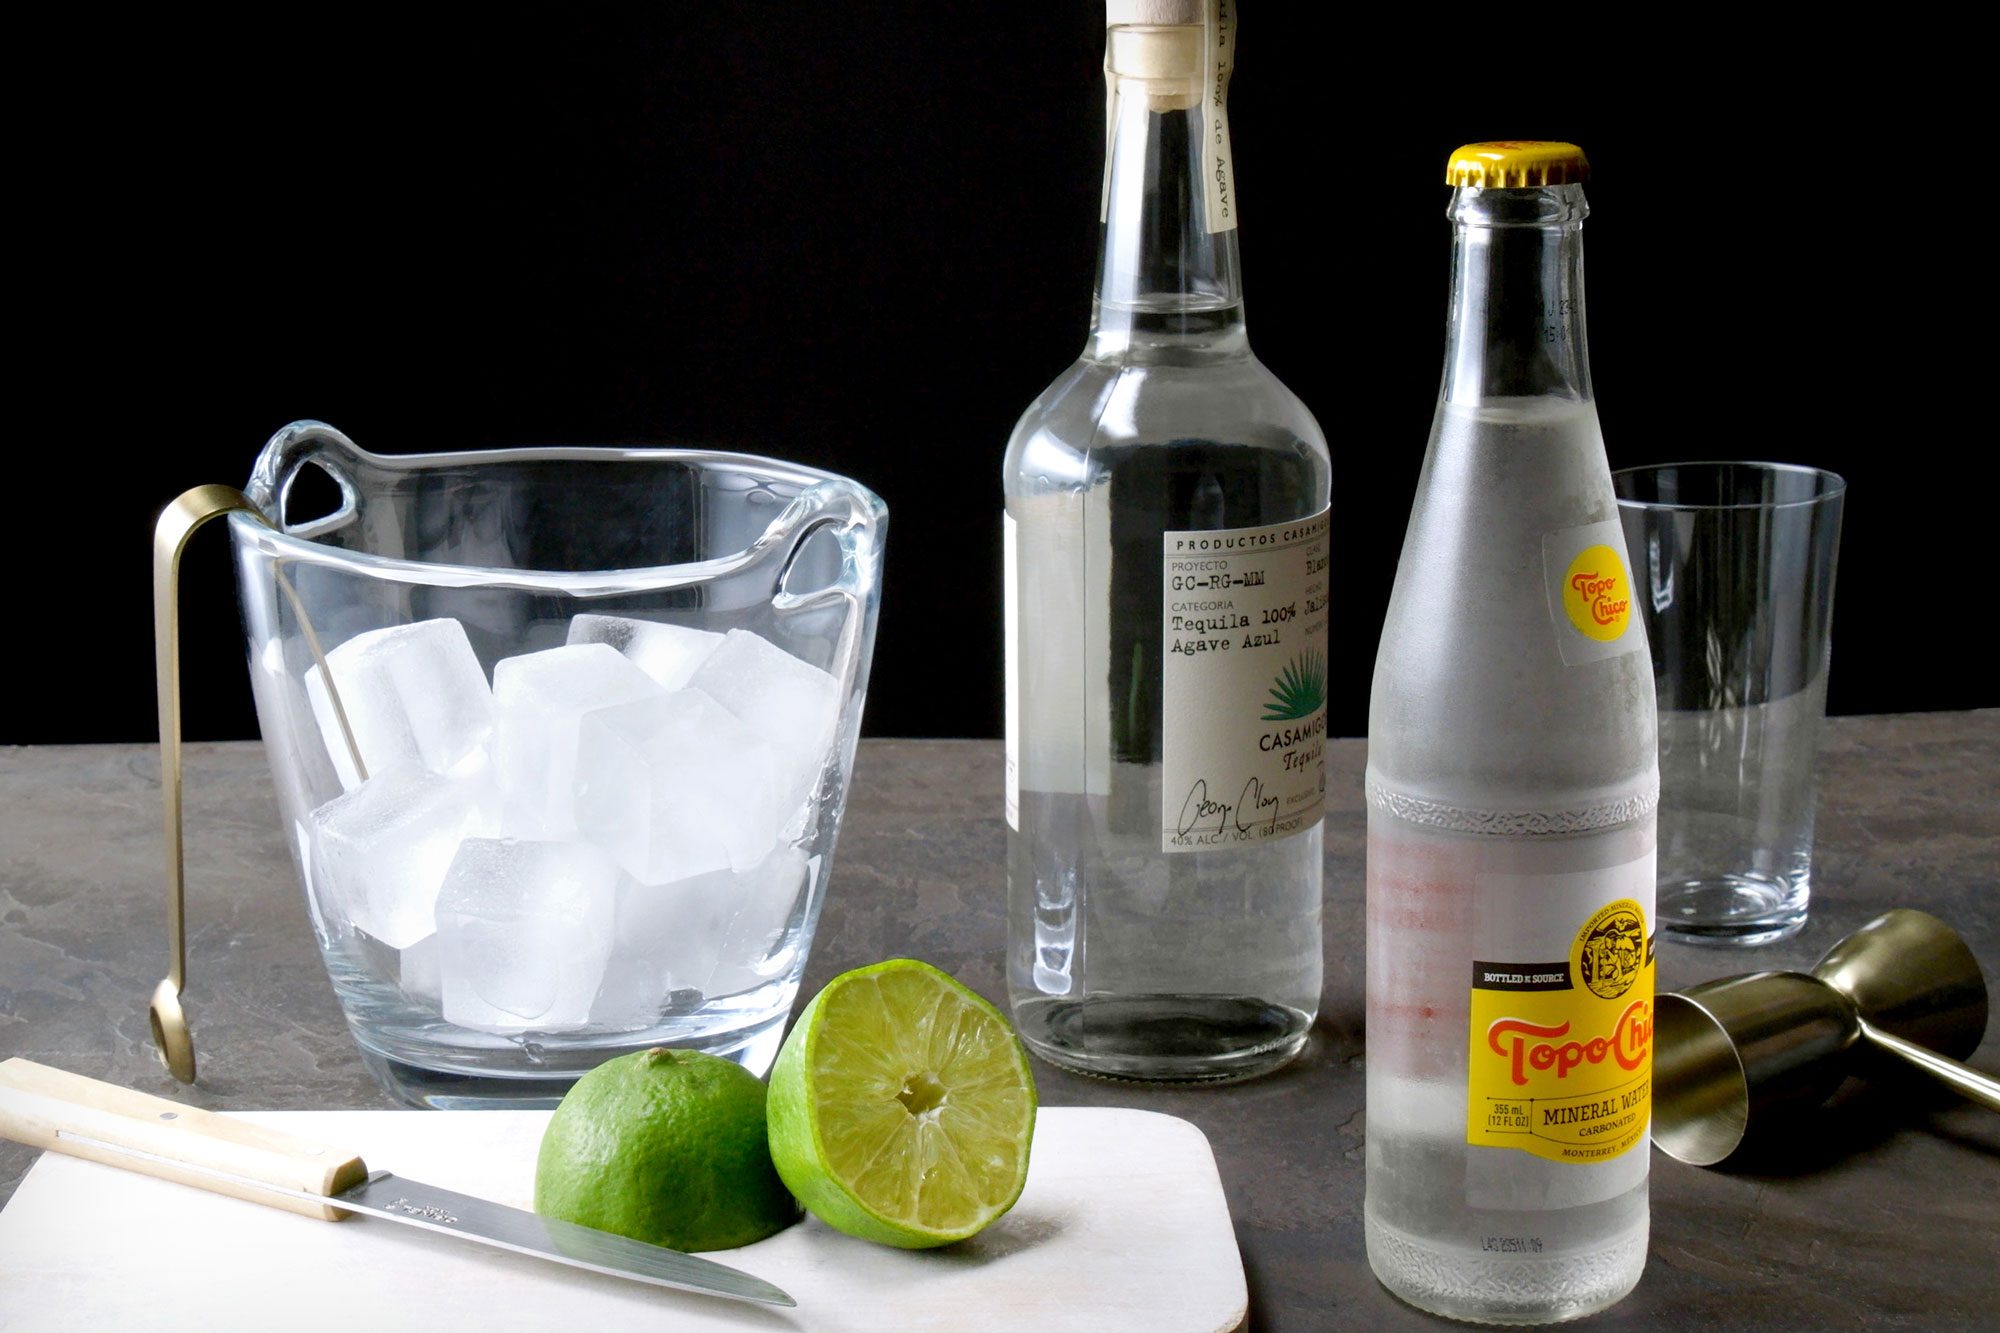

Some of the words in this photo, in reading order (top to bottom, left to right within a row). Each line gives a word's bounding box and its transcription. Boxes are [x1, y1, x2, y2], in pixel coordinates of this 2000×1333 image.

[1213, 61, 1226, 107] 100%
[1214, 119, 1223, 145] de
[1215, 156, 1229, 218] Agave
[1176, 533, 1276, 551] PRODUCTOS
[1171, 560, 1228, 572] PROYECTO
[1572, 571, 1616, 602] Topo
[1171, 600, 1235, 612] CATEGORIA
[1171, 613, 1250, 635] Tequila
[1262, 602, 1297, 624] 100%
[1592, 595, 1628, 626] Chico
[1171, 638, 1230, 656] Agave
[1242, 630, 1281, 650] Azul
[1170, 835, 1193, 846] 40%
[1197, 833, 1219, 845] ALC
[1231, 830, 1253, 841] VOL
[1579, 909, 1610, 942] IMPORTED
[1484, 973, 1523, 983] BOTTLED
[1532, 973, 1564, 983] SOURCE
[1488, 1017, 1609, 1086] Topo
[1494, 1103, 1509, 1115] 355
[1503, 1116, 1513, 1126] FL
[1543, 1098, 1618, 1126] MINERAL
[1579, 1112, 1636, 1137] CARBONATED
